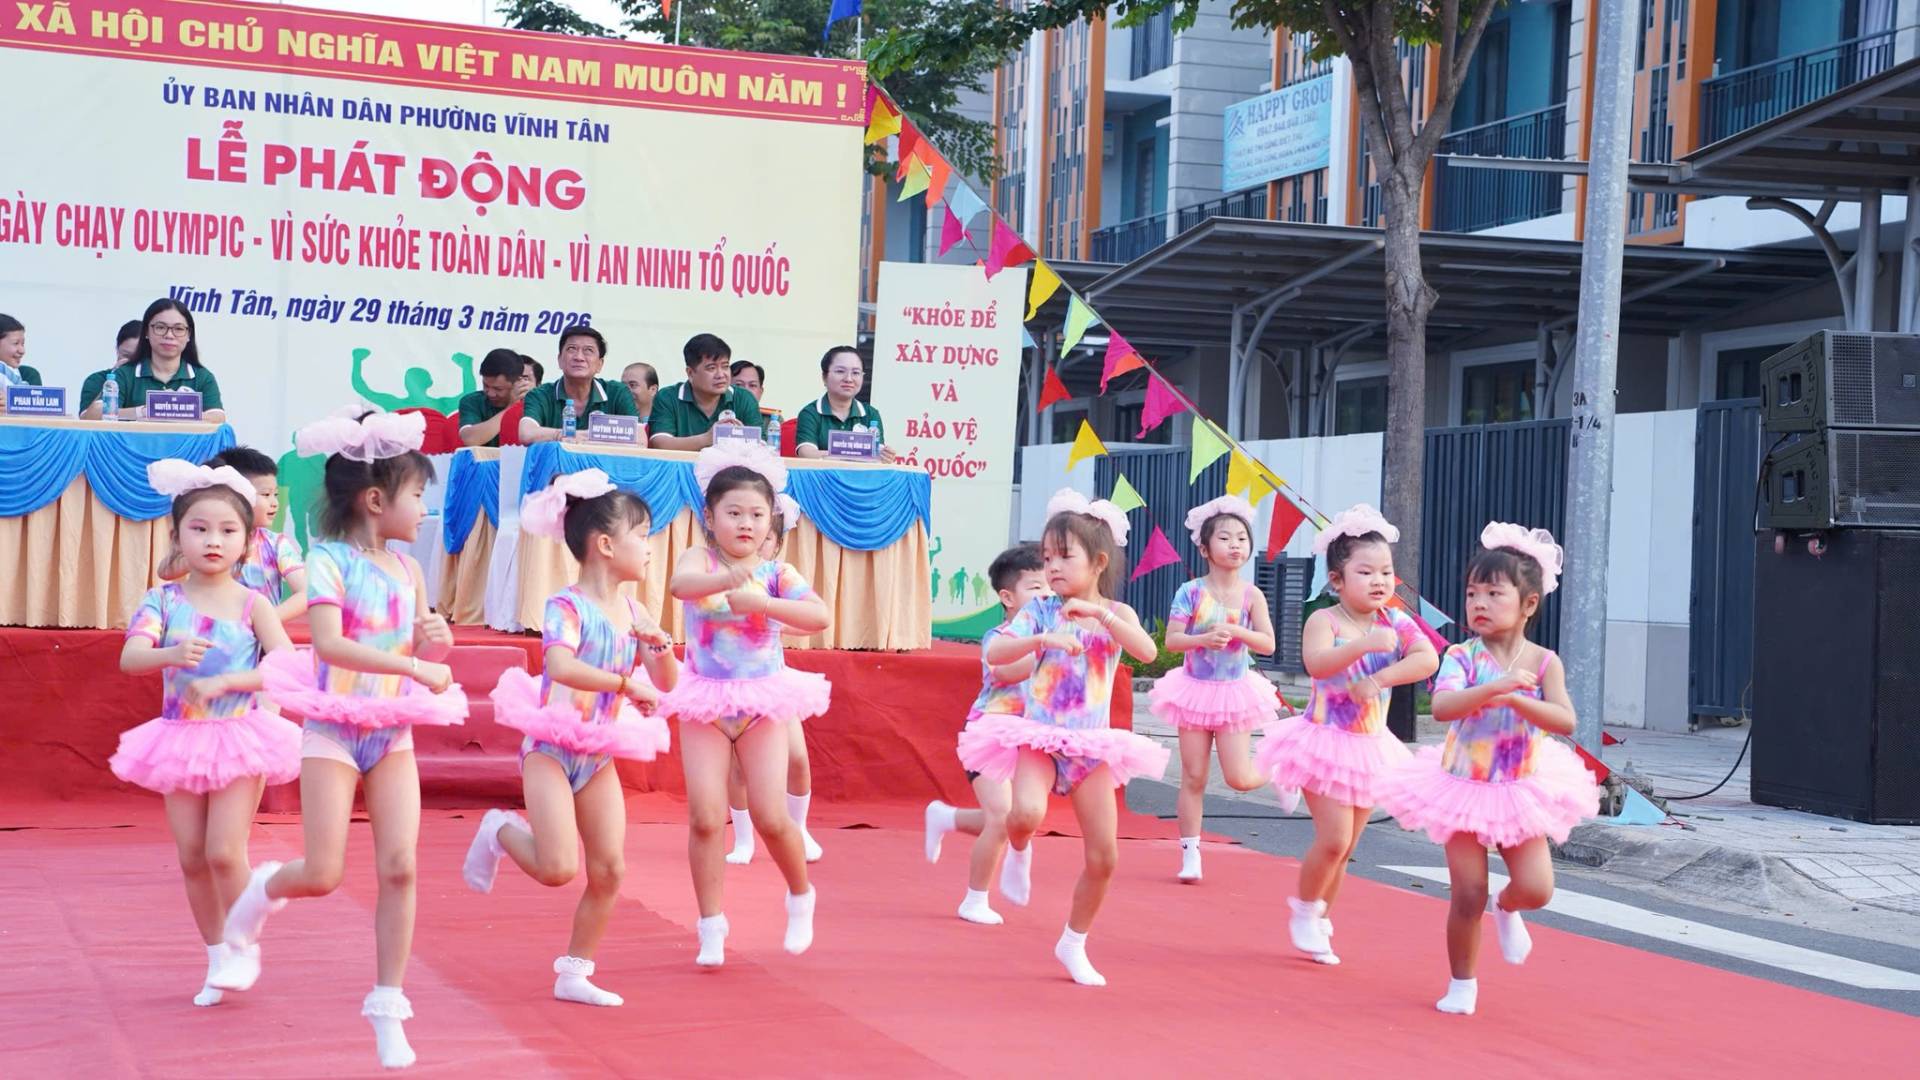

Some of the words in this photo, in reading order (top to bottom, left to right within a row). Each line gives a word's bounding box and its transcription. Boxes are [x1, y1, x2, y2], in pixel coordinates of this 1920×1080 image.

[17, 2, 75, 33] XÃ
[92, 10, 162, 47] HỘI
[180, 17, 262, 51] CHỦ
[278, 29, 401, 66] NGHĨA
[416, 44, 498, 79] VIỆT
[512, 54, 599, 85] NAM
[614, 64, 725, 97] MUÔN
[739, 74, 821, 105] NĂM
[163, 77, 195, 105] ỦY
[204, 87, 255, 111] BAN
[265, 92, 333, 118] NHÂN
[343, 97, 391, 123] DÂN
[400, 105, 496, 133] PHƯỜNG
[505, 113, 557, 139] VĨNH
[566, 118, 609, 143] TÂN
[1247, 94, 1288, 126] HAPPY
[1292, 83, 1332, 110] GROU
[185, 119, 248, 184] LỄ
[262, 139, 406, 196] PHÁT
[417, 150, 586, 216] ĐỘNG
[0, 191, 47, 245] GÀY
[55, 202, 125, 259] CHẠY
[133, 208, 245, 259] OLYMPIC
[270, 210, 294, 262] VÌ
[300, 213, 351, 266] SỨC
[358, 212, 422, 271] KHỎE
[427, 224, 492, 277] TOÀN
[496, 228, 545, 280] DÂN
[568, 233, 591, 284] VÌ
[596, 243, 630, 286] AN
[635, 246, 692, 289] NINH
[698, 236, 726, 292] TỔ
[731, 245, 791, 298] QUỐC
[230, 290, 277, 319] Tân,
[286, 294, 346, 323] ngày
[350, 298, 381, 322] 29
[387, 300, 453, 330] tháng
[458, 305, 474, 329] 3
[479, 307, 529, 332] năm
[536, 310, 592, 335] 2026
[970, 300, 996, 329] ĐỂ
[896, 340, 936, 364] XÂY
[942, 345, 998, 368] DỰNG
[13, 396, 31, 405] PHAN
[32, 395, 45, 406] VĂN
[46, 397, 59, 406] LAM
[931, 379, 959, 401] VÀ
[905, 412, 947, 439] BẢO
[951, 416, 976, 447] VỆ
